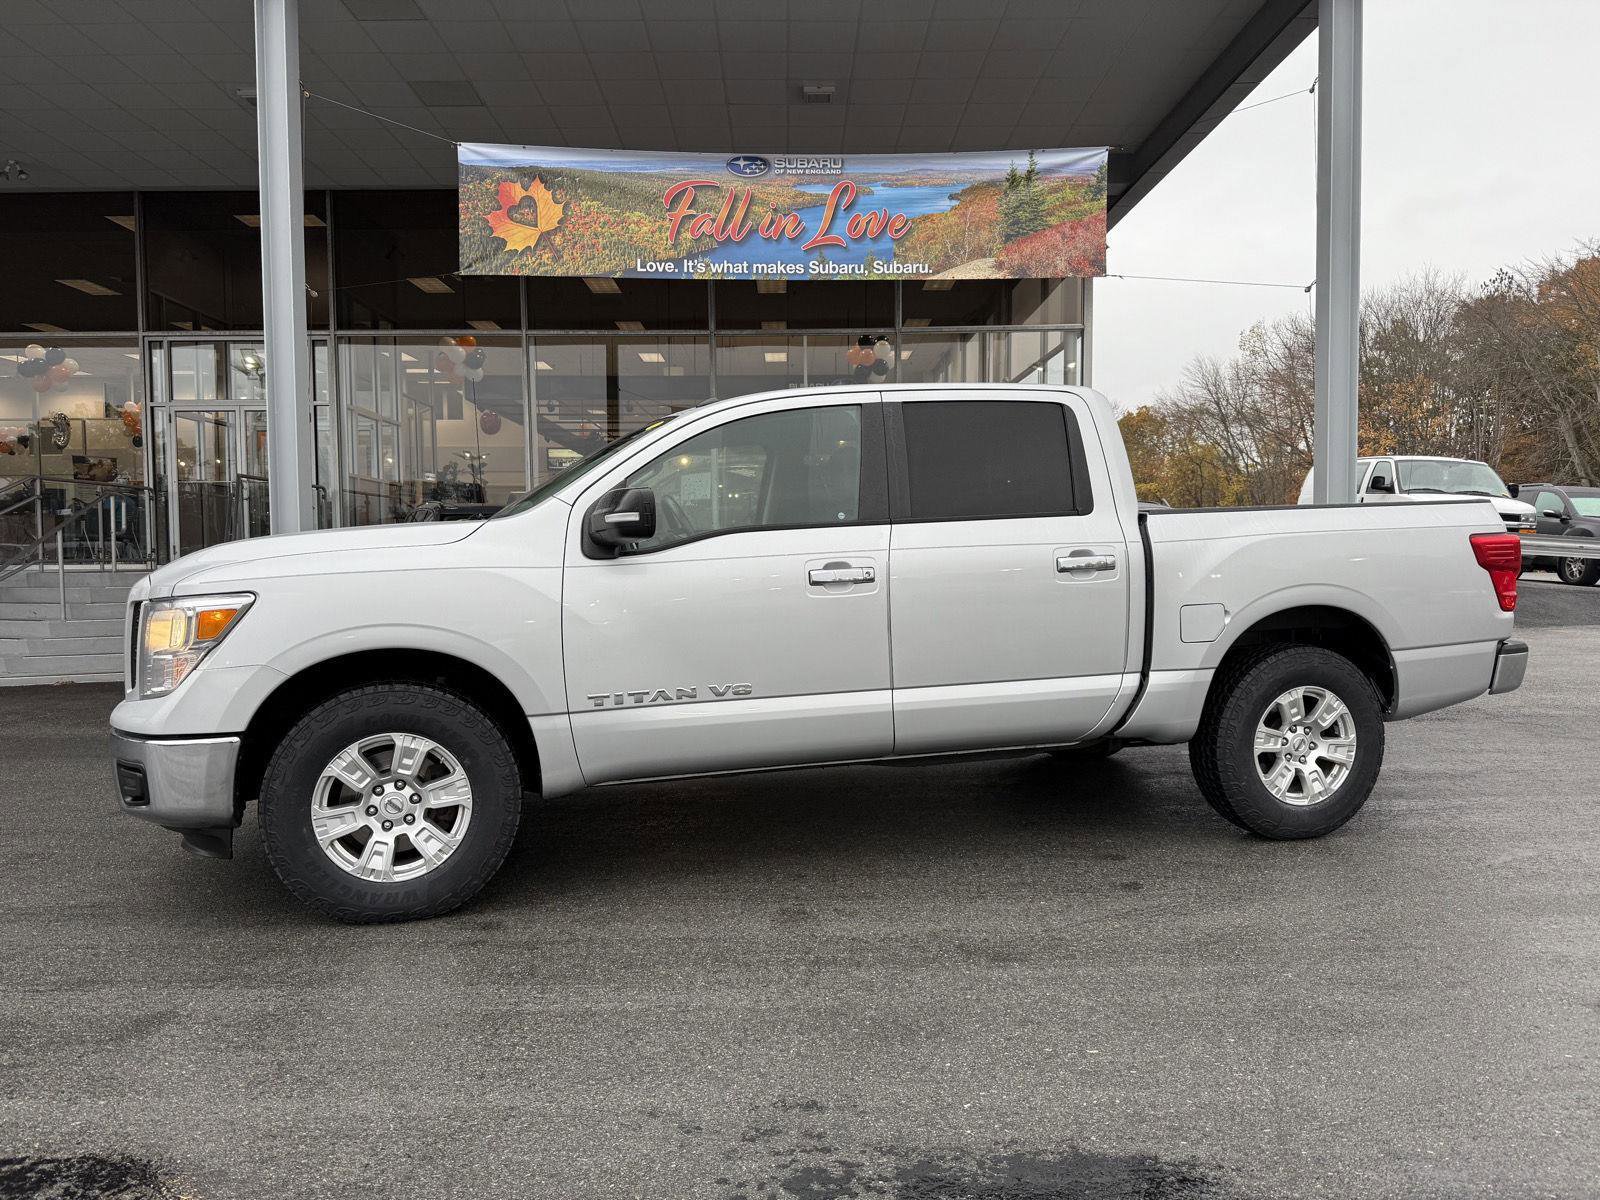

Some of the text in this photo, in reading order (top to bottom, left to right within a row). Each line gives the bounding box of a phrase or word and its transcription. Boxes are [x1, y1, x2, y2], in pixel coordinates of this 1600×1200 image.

[774, 158, 842, 168] SUBARU
[663, 180, 912, 250] Fall in Love
[637, 259, 933, 276] Love. It's what makes Subaru, Subaru.
[587, 686, 697, 707] TITAN
